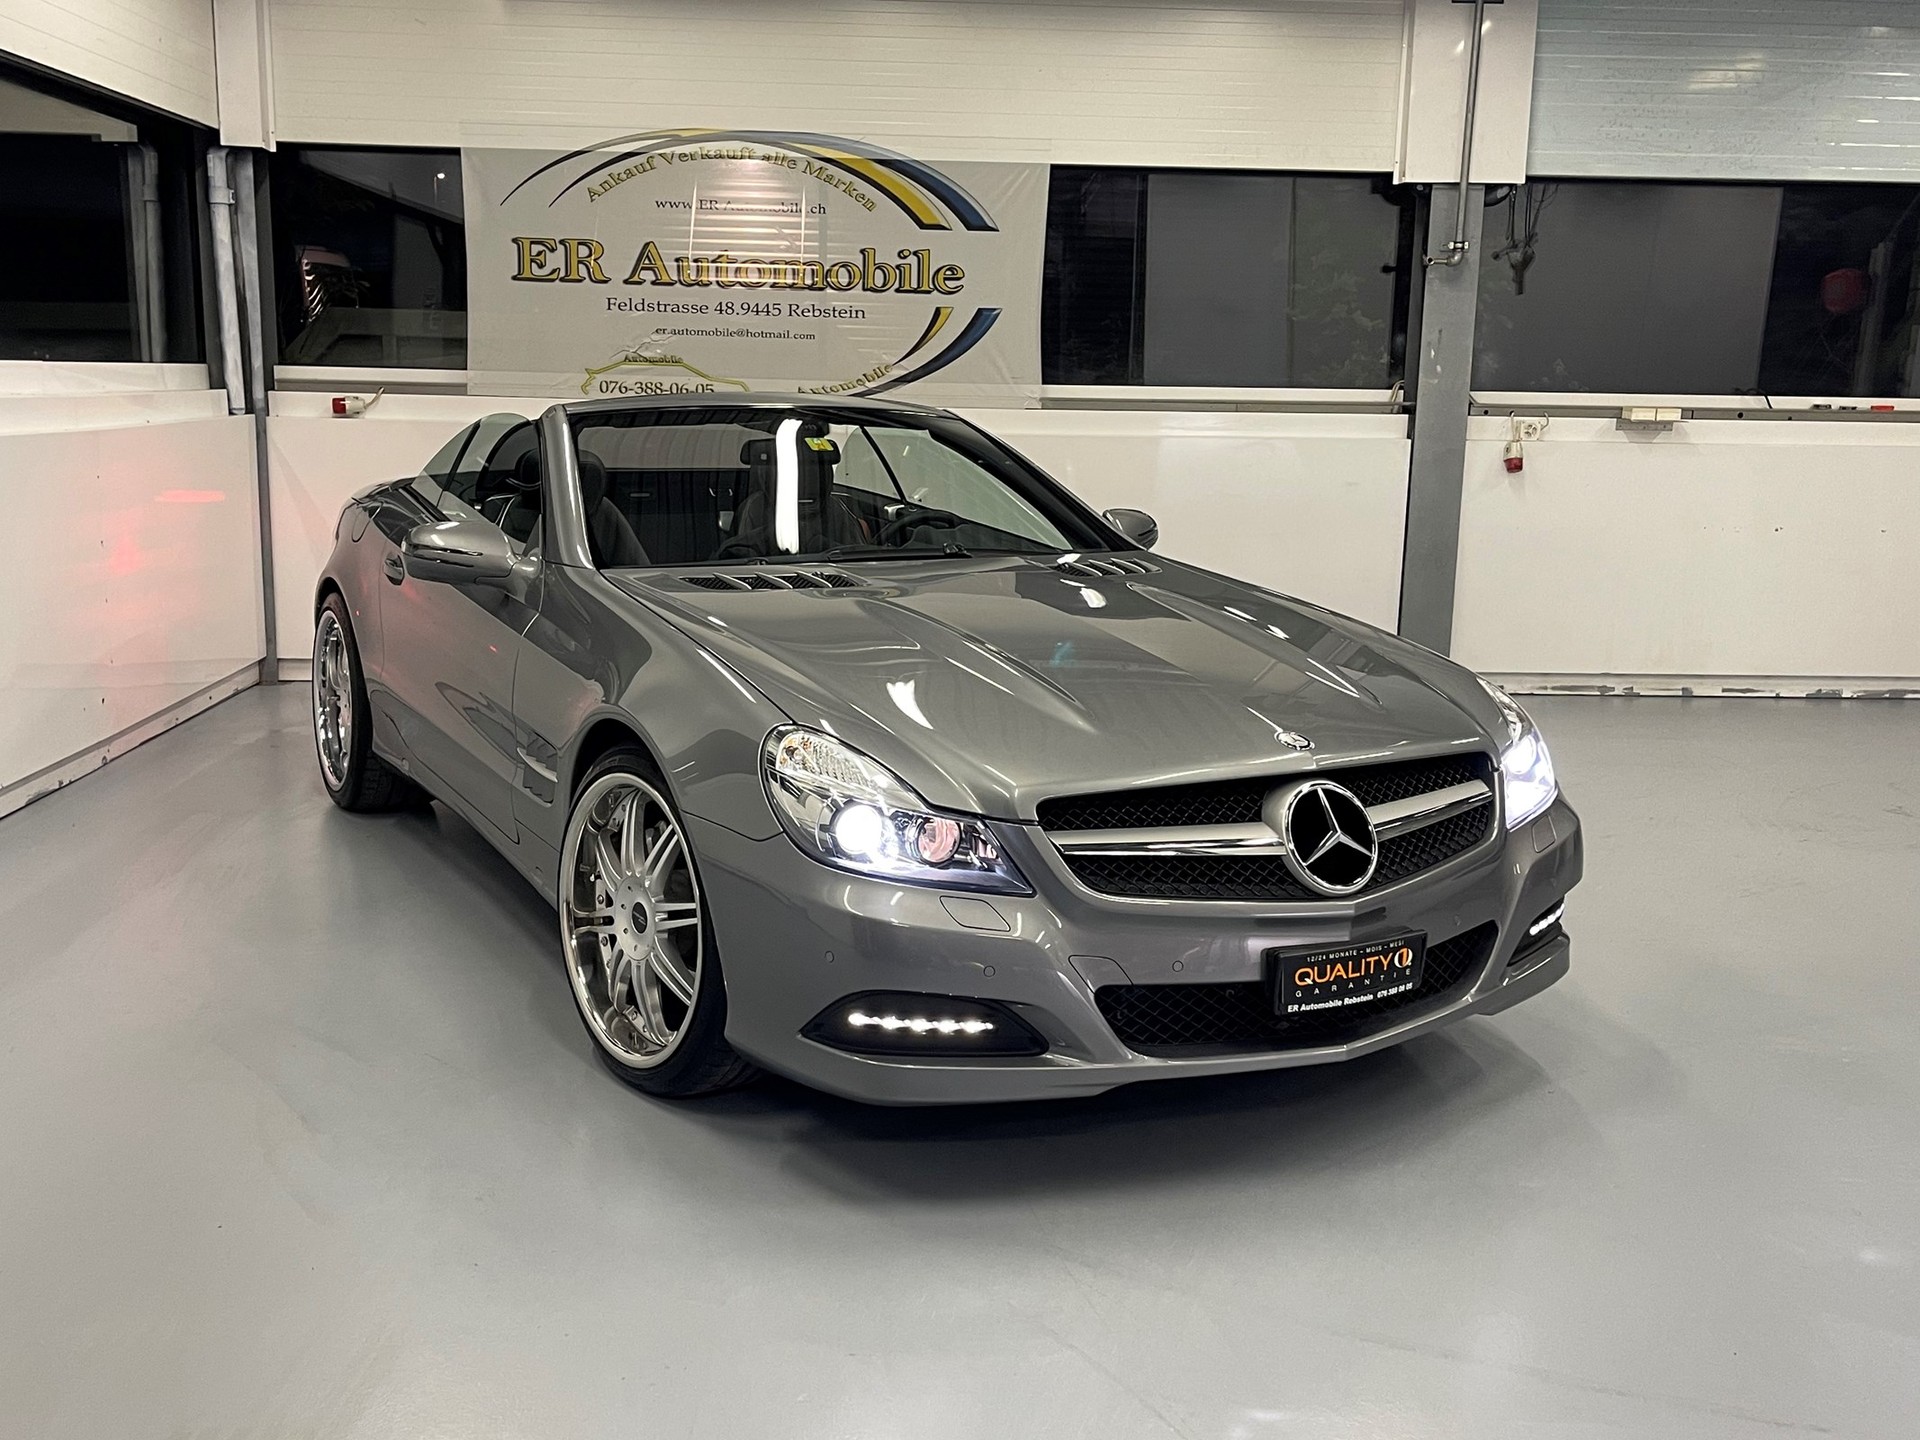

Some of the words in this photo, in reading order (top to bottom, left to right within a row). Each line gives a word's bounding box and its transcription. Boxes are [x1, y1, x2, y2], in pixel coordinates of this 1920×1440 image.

[586, 156, 656, 202] Ankauf
[761, 152, 797, 169] alle
[801, 160, 877, 212] Marken
[511, 236, 612, 284] ER
[622, 241, 966, 294] Automobile
[606, 297, 709, 315] Feldstrasse
[713, 301, 783, 317] 48.9445
[787, 303, 866, 320] Rebstein
[654, 327, 816, 341] er.automobile@hotmail.com
[599, 379, 715, 395] 076-388-06-05
[1329, 949, 1358, 959] MONATE
[1366, 945, 1382, 953] MOIS
[1294, 952, 1393, 987] QUALITY
[1287, 1004, 1299, 1013] ER
[1300, 999, 1342, 1012] Automobile
